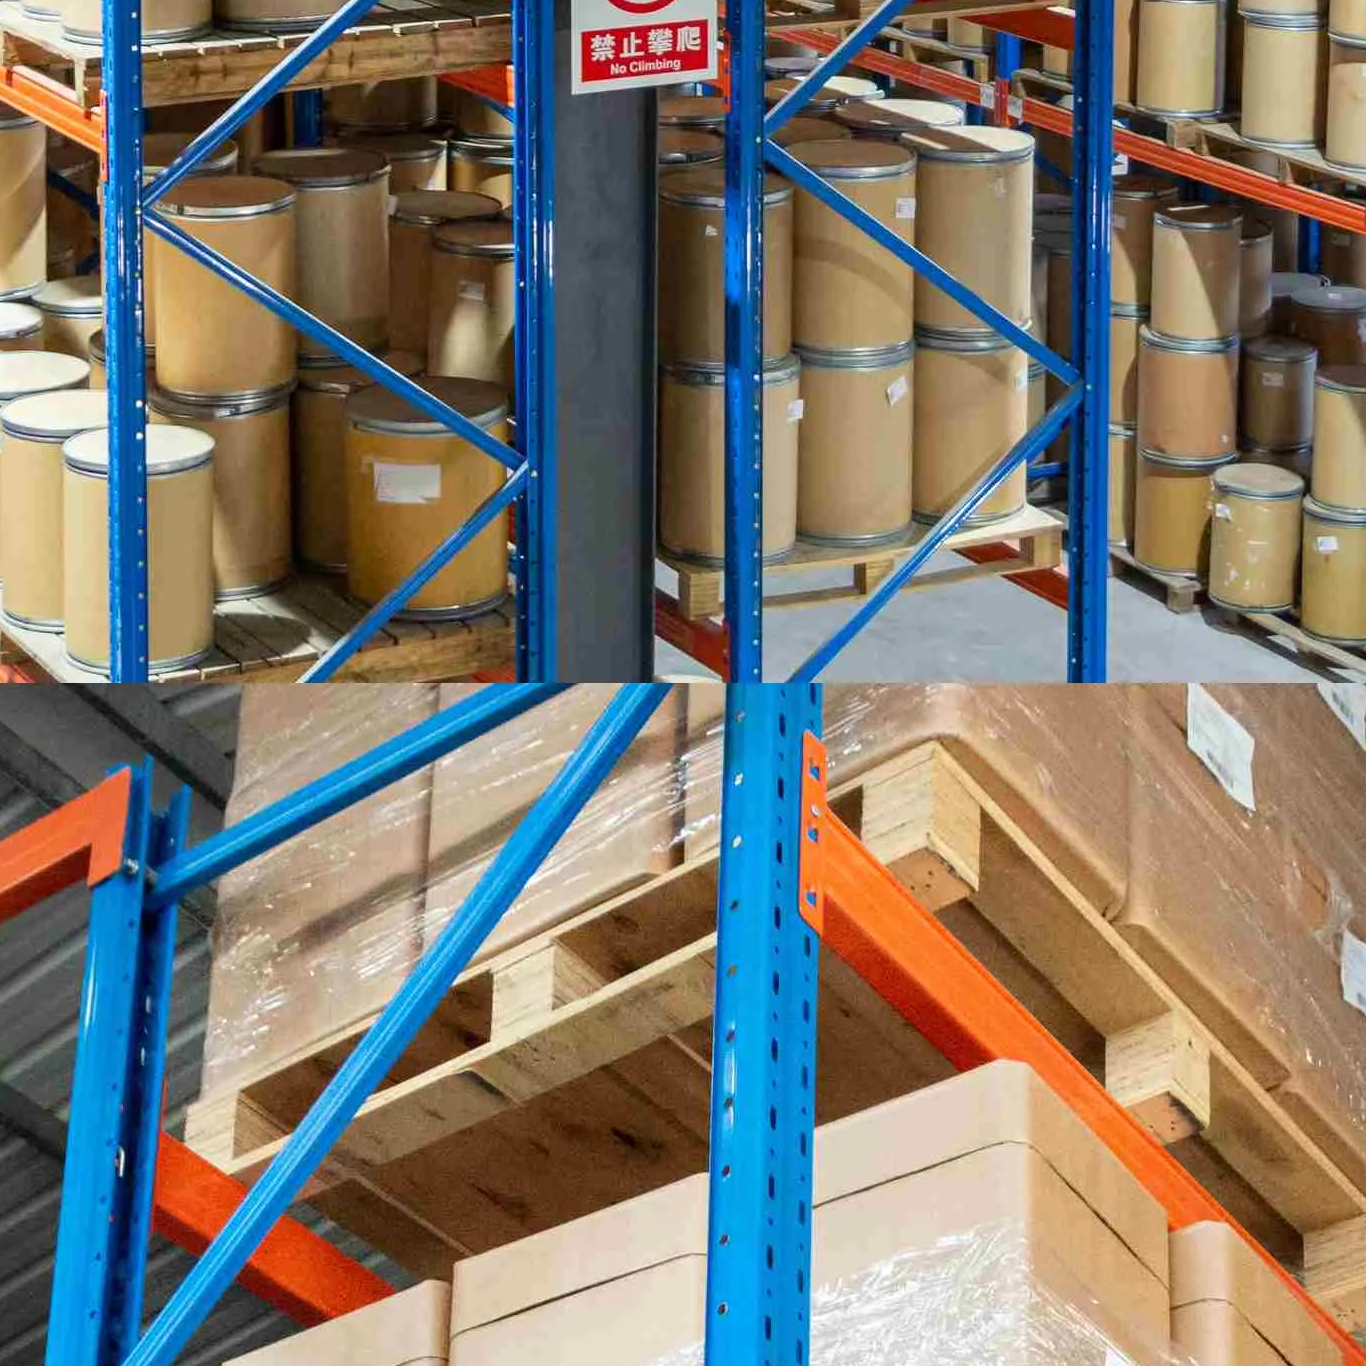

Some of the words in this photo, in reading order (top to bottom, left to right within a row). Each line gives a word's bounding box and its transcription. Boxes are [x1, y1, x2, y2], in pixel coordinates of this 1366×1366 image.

[590, 26, 702, 62] 禁止攀爬
[610, 63, 627, 75] No
[629, 59, 682, 72] Climbing
